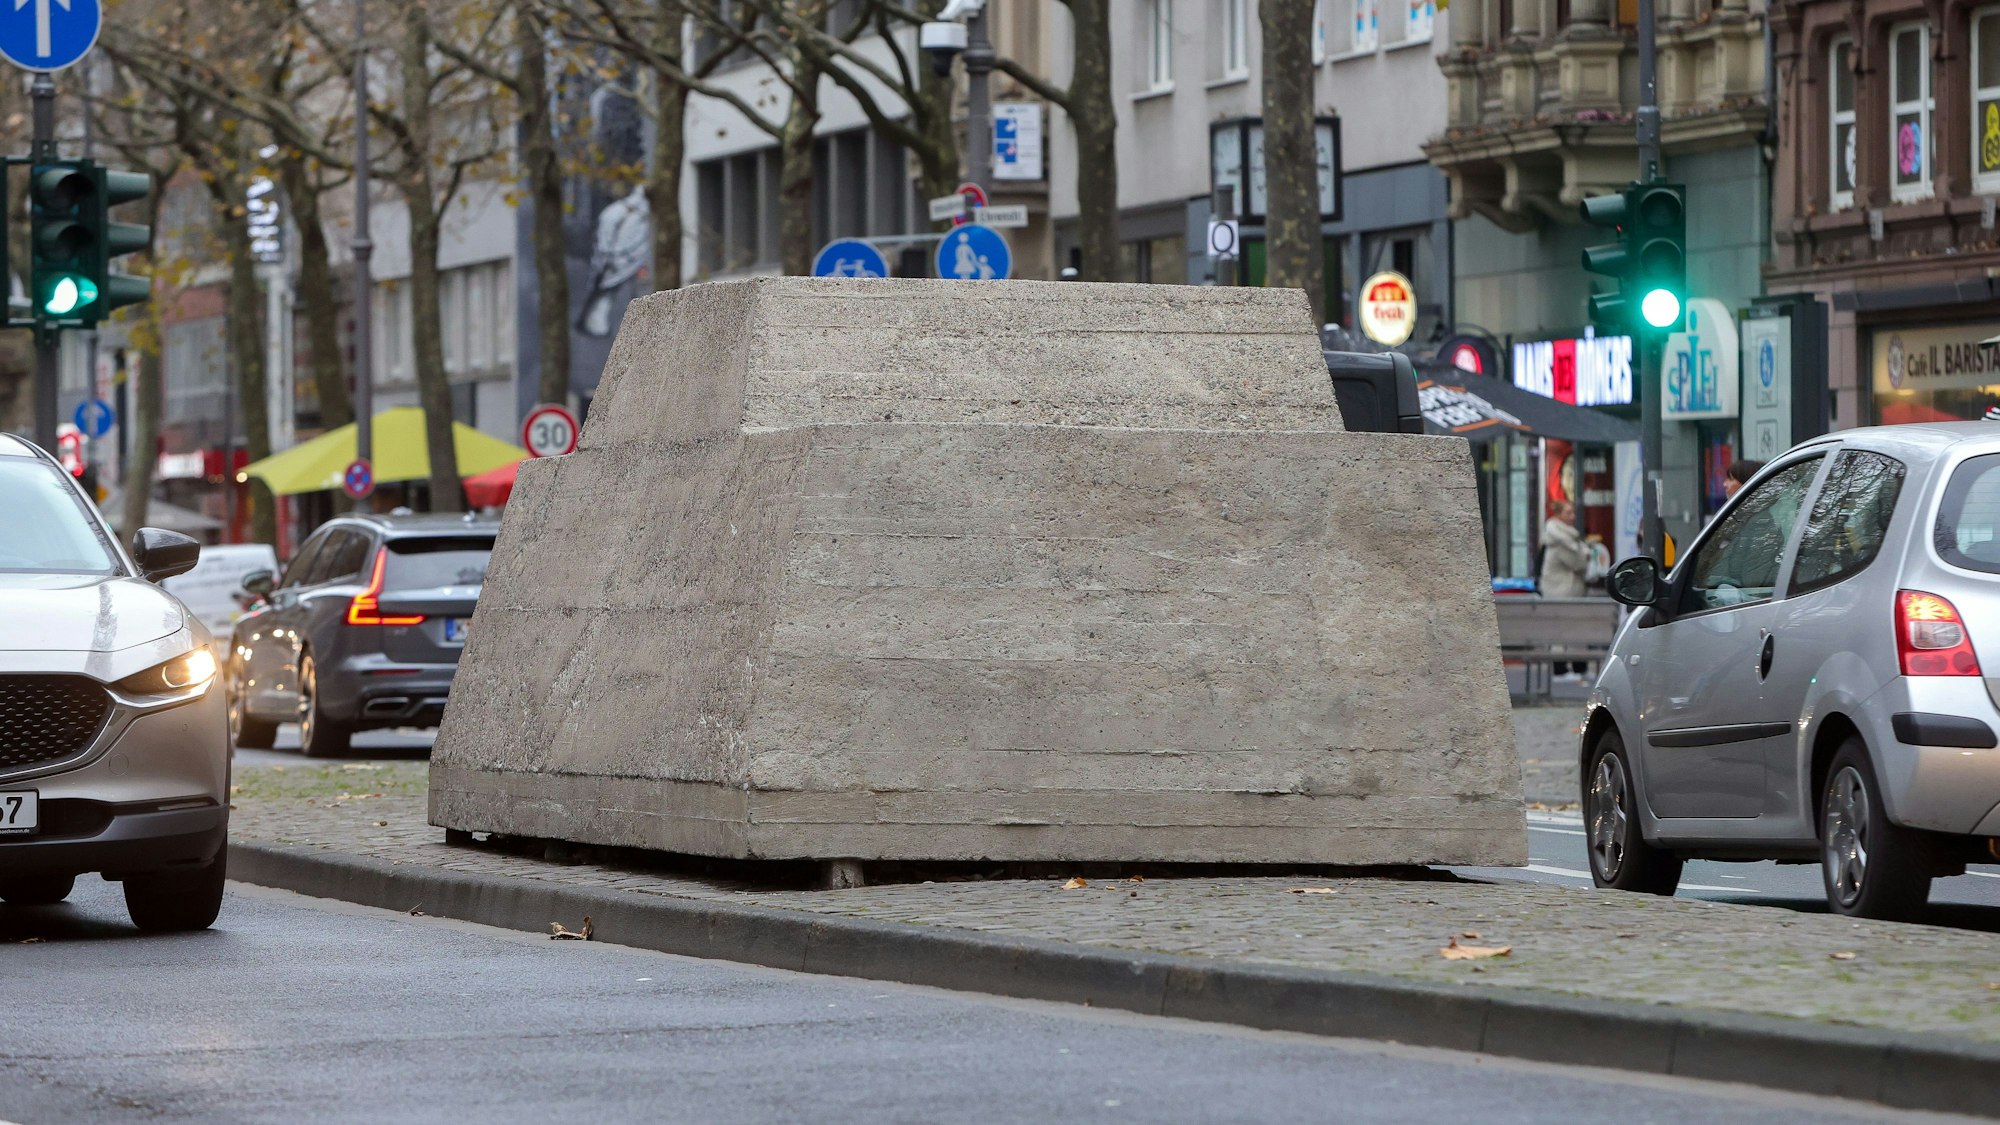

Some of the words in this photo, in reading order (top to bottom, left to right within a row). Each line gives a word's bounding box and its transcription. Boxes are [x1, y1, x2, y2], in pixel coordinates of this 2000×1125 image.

[1929, 345, 1941, 375] IL
[536, 421, 567, 449] 30
[0, 796, 23, 824] 7
